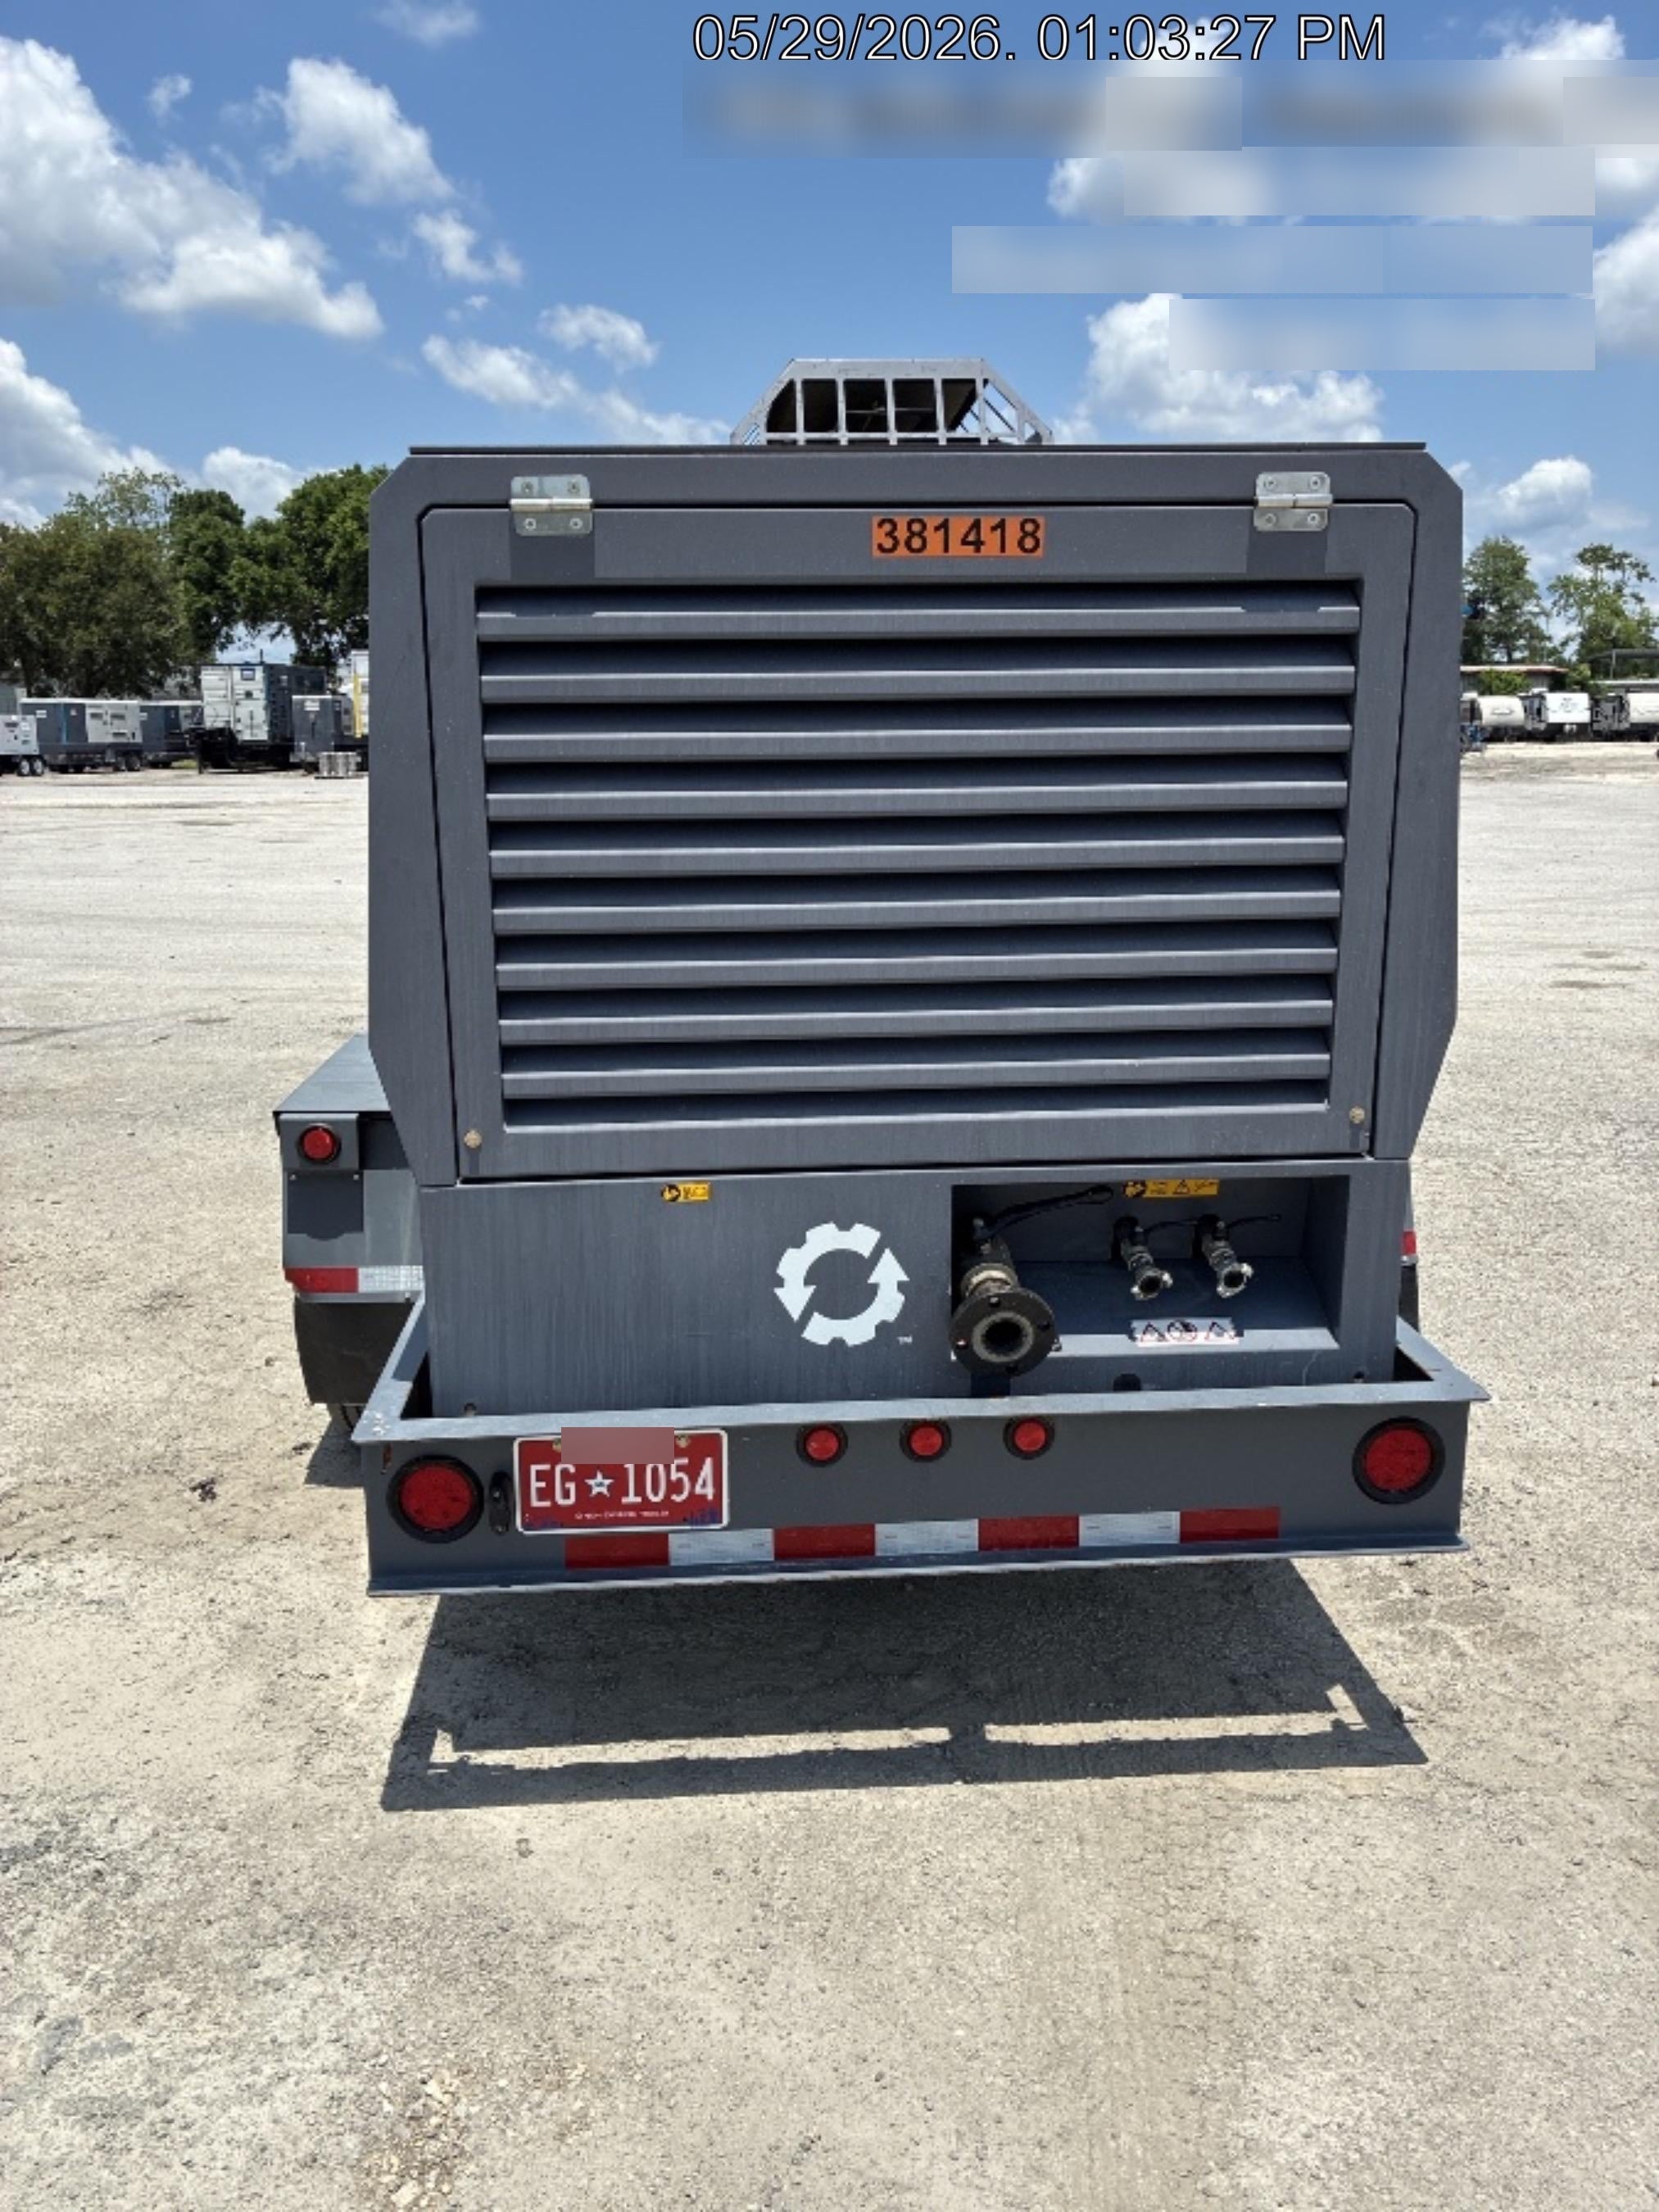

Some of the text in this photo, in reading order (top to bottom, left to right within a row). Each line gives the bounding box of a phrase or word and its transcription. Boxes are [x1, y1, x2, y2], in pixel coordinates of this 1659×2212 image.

[876, 517, 1041, 554] 381418
[529, 1456, 715, 1508] EG 1054
